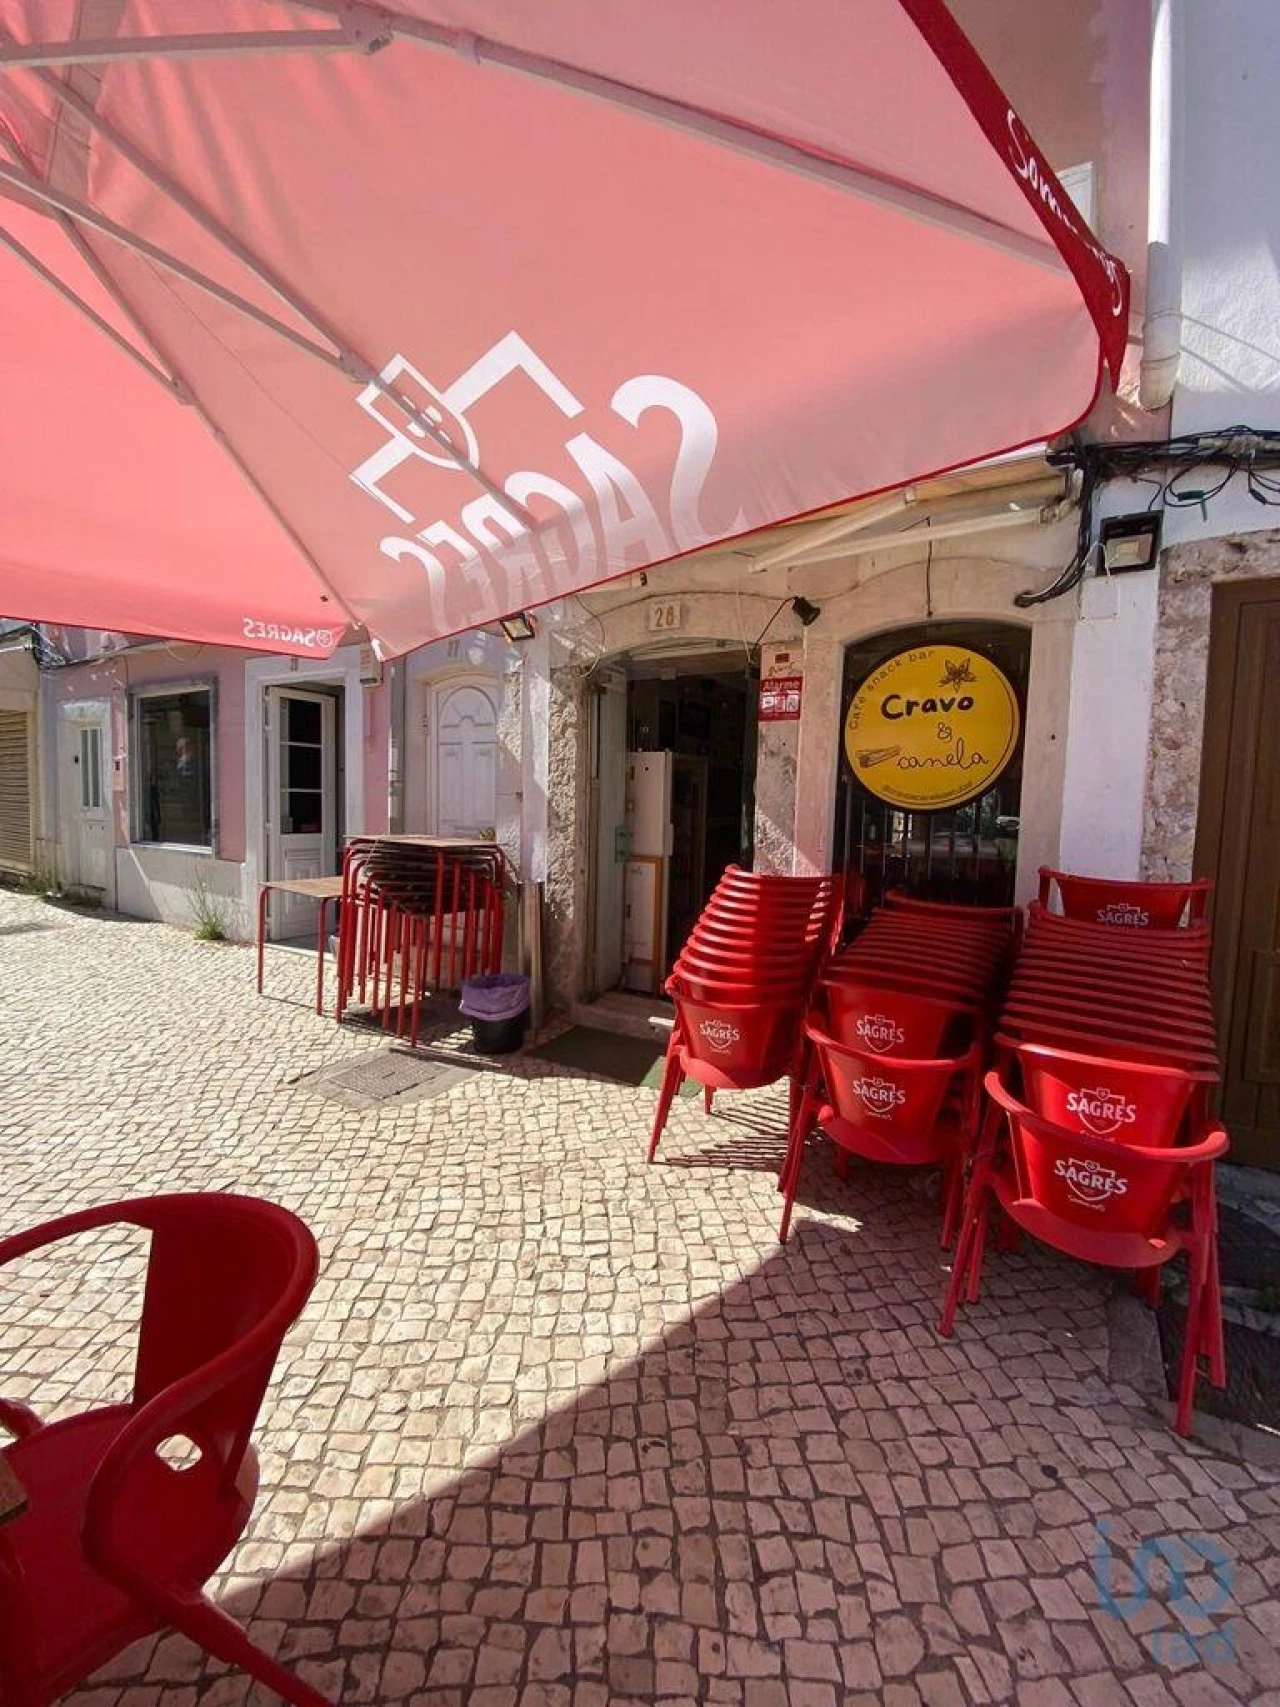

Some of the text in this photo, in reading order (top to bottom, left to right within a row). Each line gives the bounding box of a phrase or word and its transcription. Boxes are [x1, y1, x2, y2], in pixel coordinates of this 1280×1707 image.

[908, 650, 936, 662] bar
[881, 694, 974, 720] Cravo
[1096, 909, 1150, 926] SAGRES
[699, 1023, 740, 1041] SAGRES
[856, 1019, 905, 1043] SAGRES
[852, 1079, 906, 1104] SAGRES
[1066, 1093, 1137, 1123] SAGRES
[1054, 1159, 1128, 1195] SAGRES
